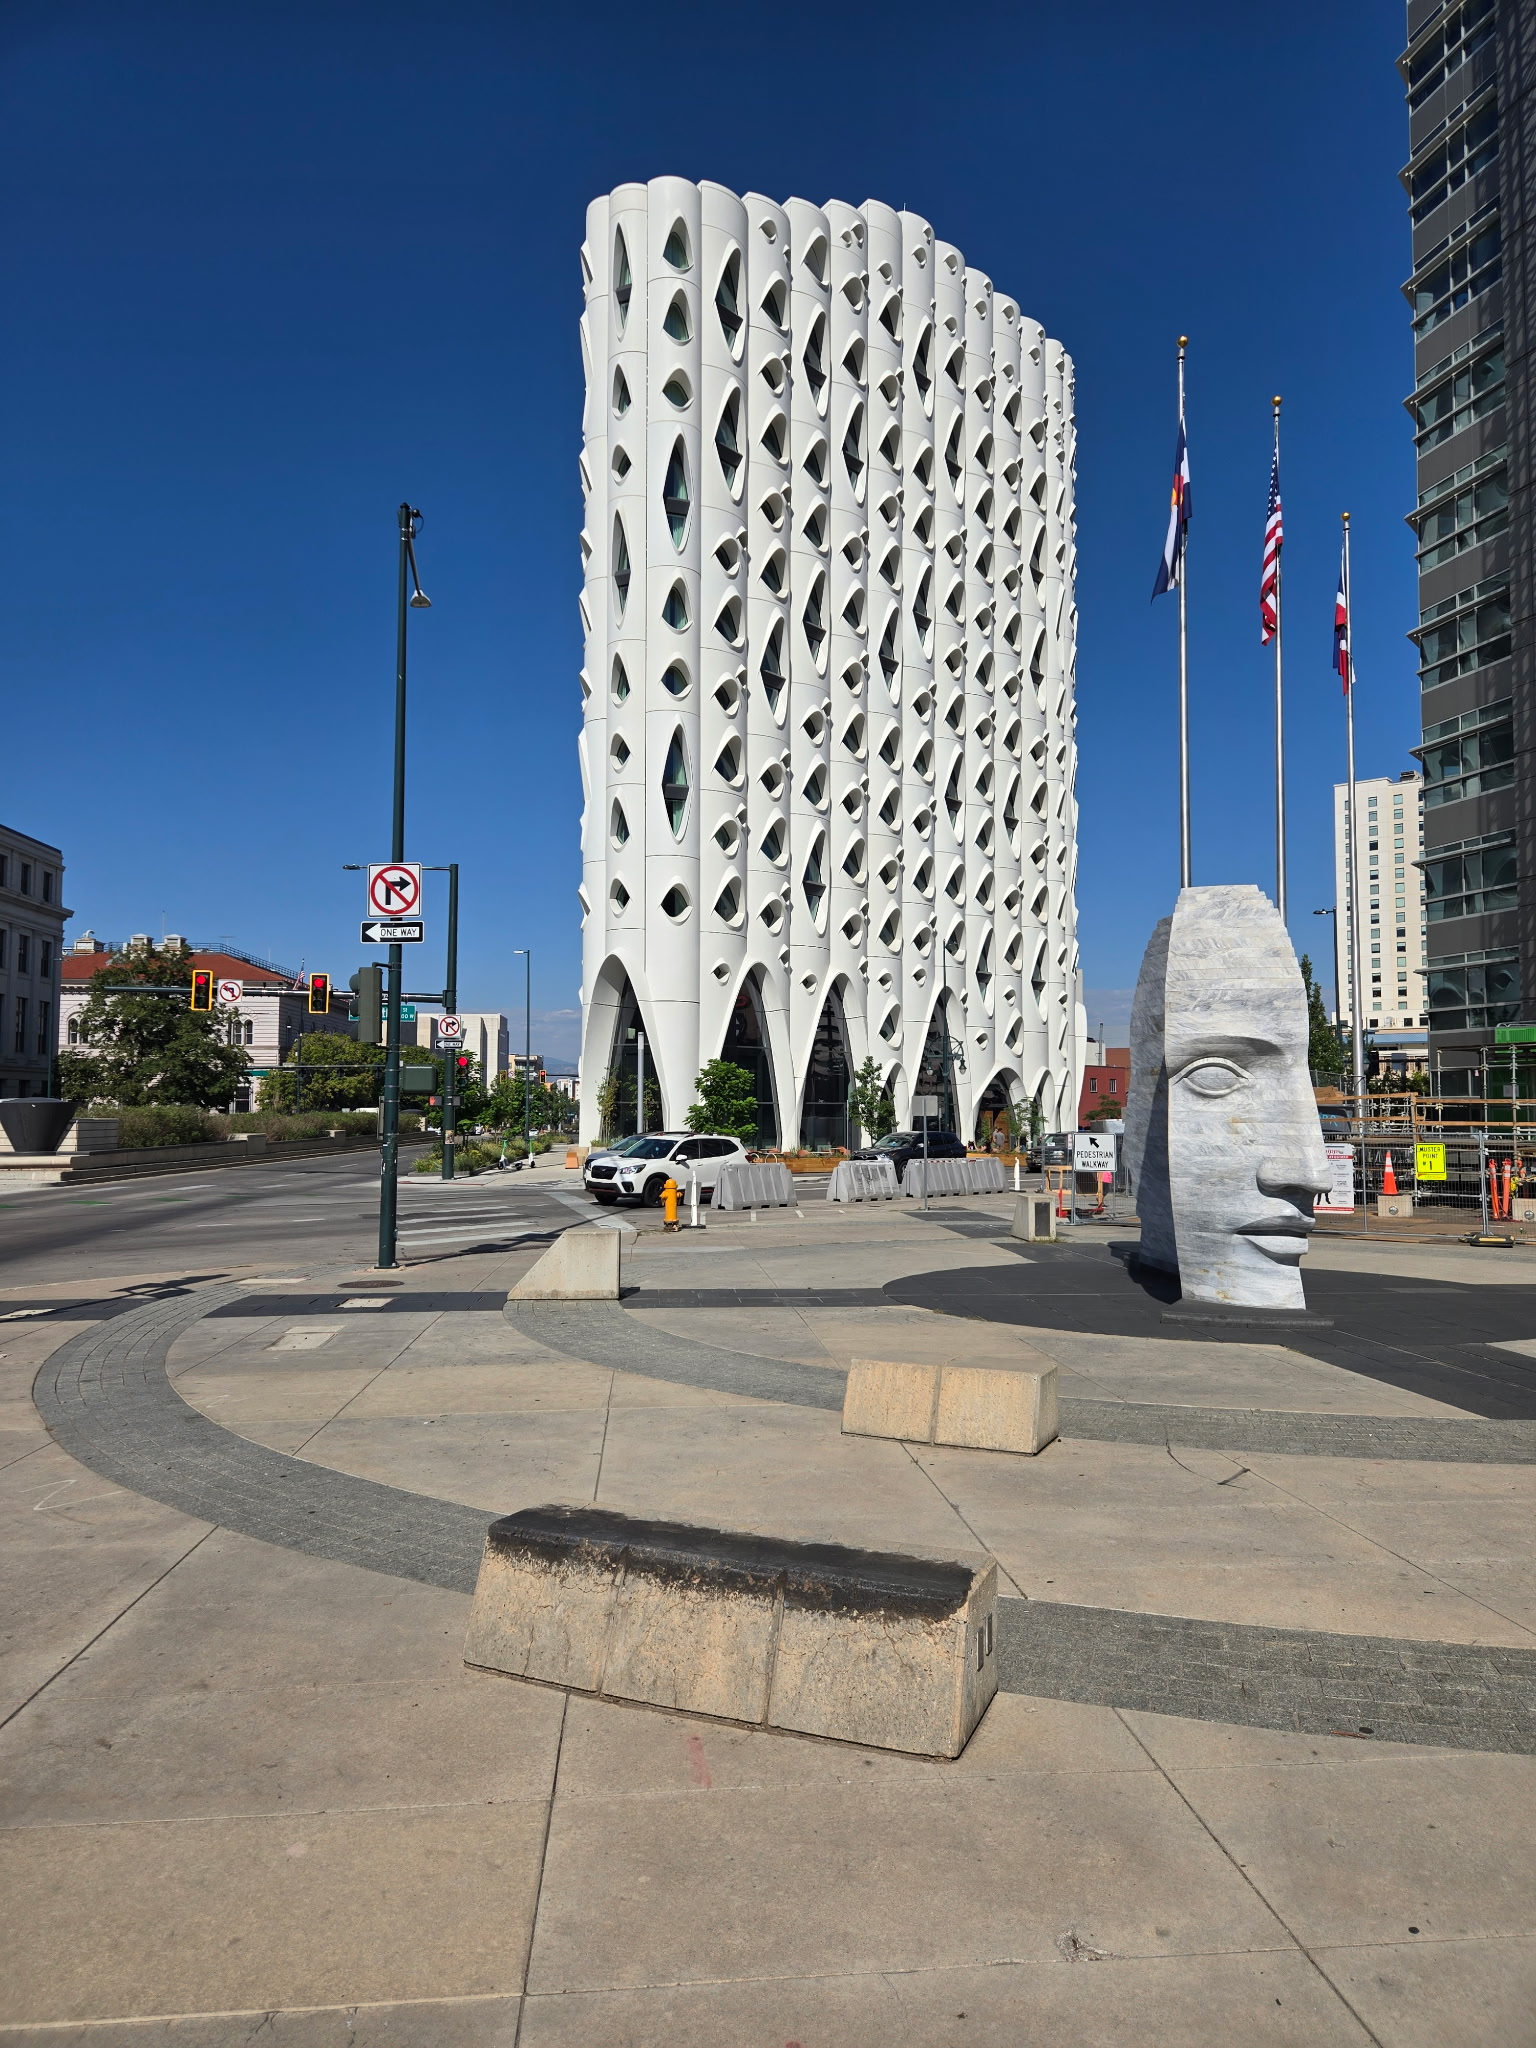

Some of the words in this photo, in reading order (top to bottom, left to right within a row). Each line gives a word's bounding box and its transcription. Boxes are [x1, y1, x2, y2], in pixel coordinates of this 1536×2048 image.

[380, 928, 398, 937] ONE
[400, 928, 417, 937] WAY
[1076, 1150, 1114, 1159] PEDESTRIAN
[1081, 1160, 1109, 1169] WALKWAY
